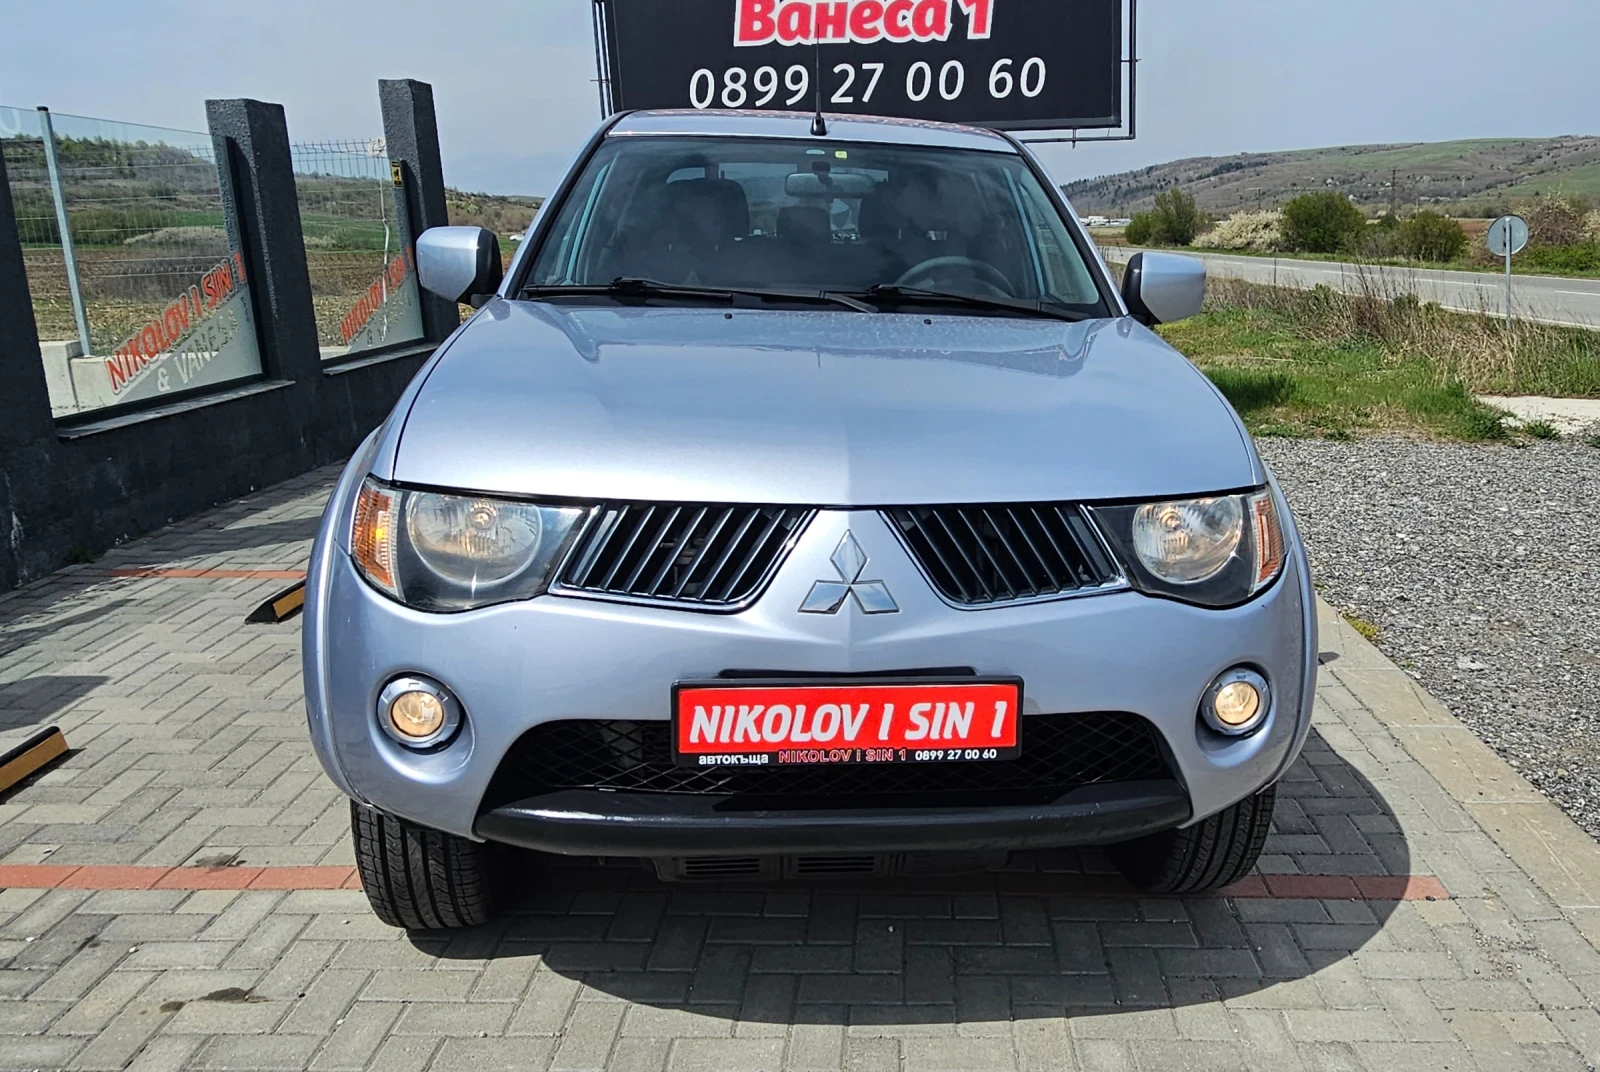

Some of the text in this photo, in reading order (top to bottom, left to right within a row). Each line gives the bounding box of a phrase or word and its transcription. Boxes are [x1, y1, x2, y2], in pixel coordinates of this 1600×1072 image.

[734, 0, 994, 46] Ванеса 1
[689, 56, 1046, 109] 0899 27 00 60
[104, 292, 191, 395] NIKOLOV
[202, 259, 234, 309] SIN
[233, 251, 246, 283] 1
[157, 366, 171, 393] &
[689, 703, 869, 743] NIKOLOV
[905, 702, 974, 741] SIN
[991, 700, 1007, 738] 1
[699, 754, 769, 765] автокъща
[778, 750, 852, 763] NIKOLOV
[865, 749, 894, 762] SIN
[899, 748, 906, 761] 1
[915, 750, 944, 761] 0899
[947, 750, 962, 760] 27
[965, 749, 980, 760] 00
[982, 748, 998, 759] 60
